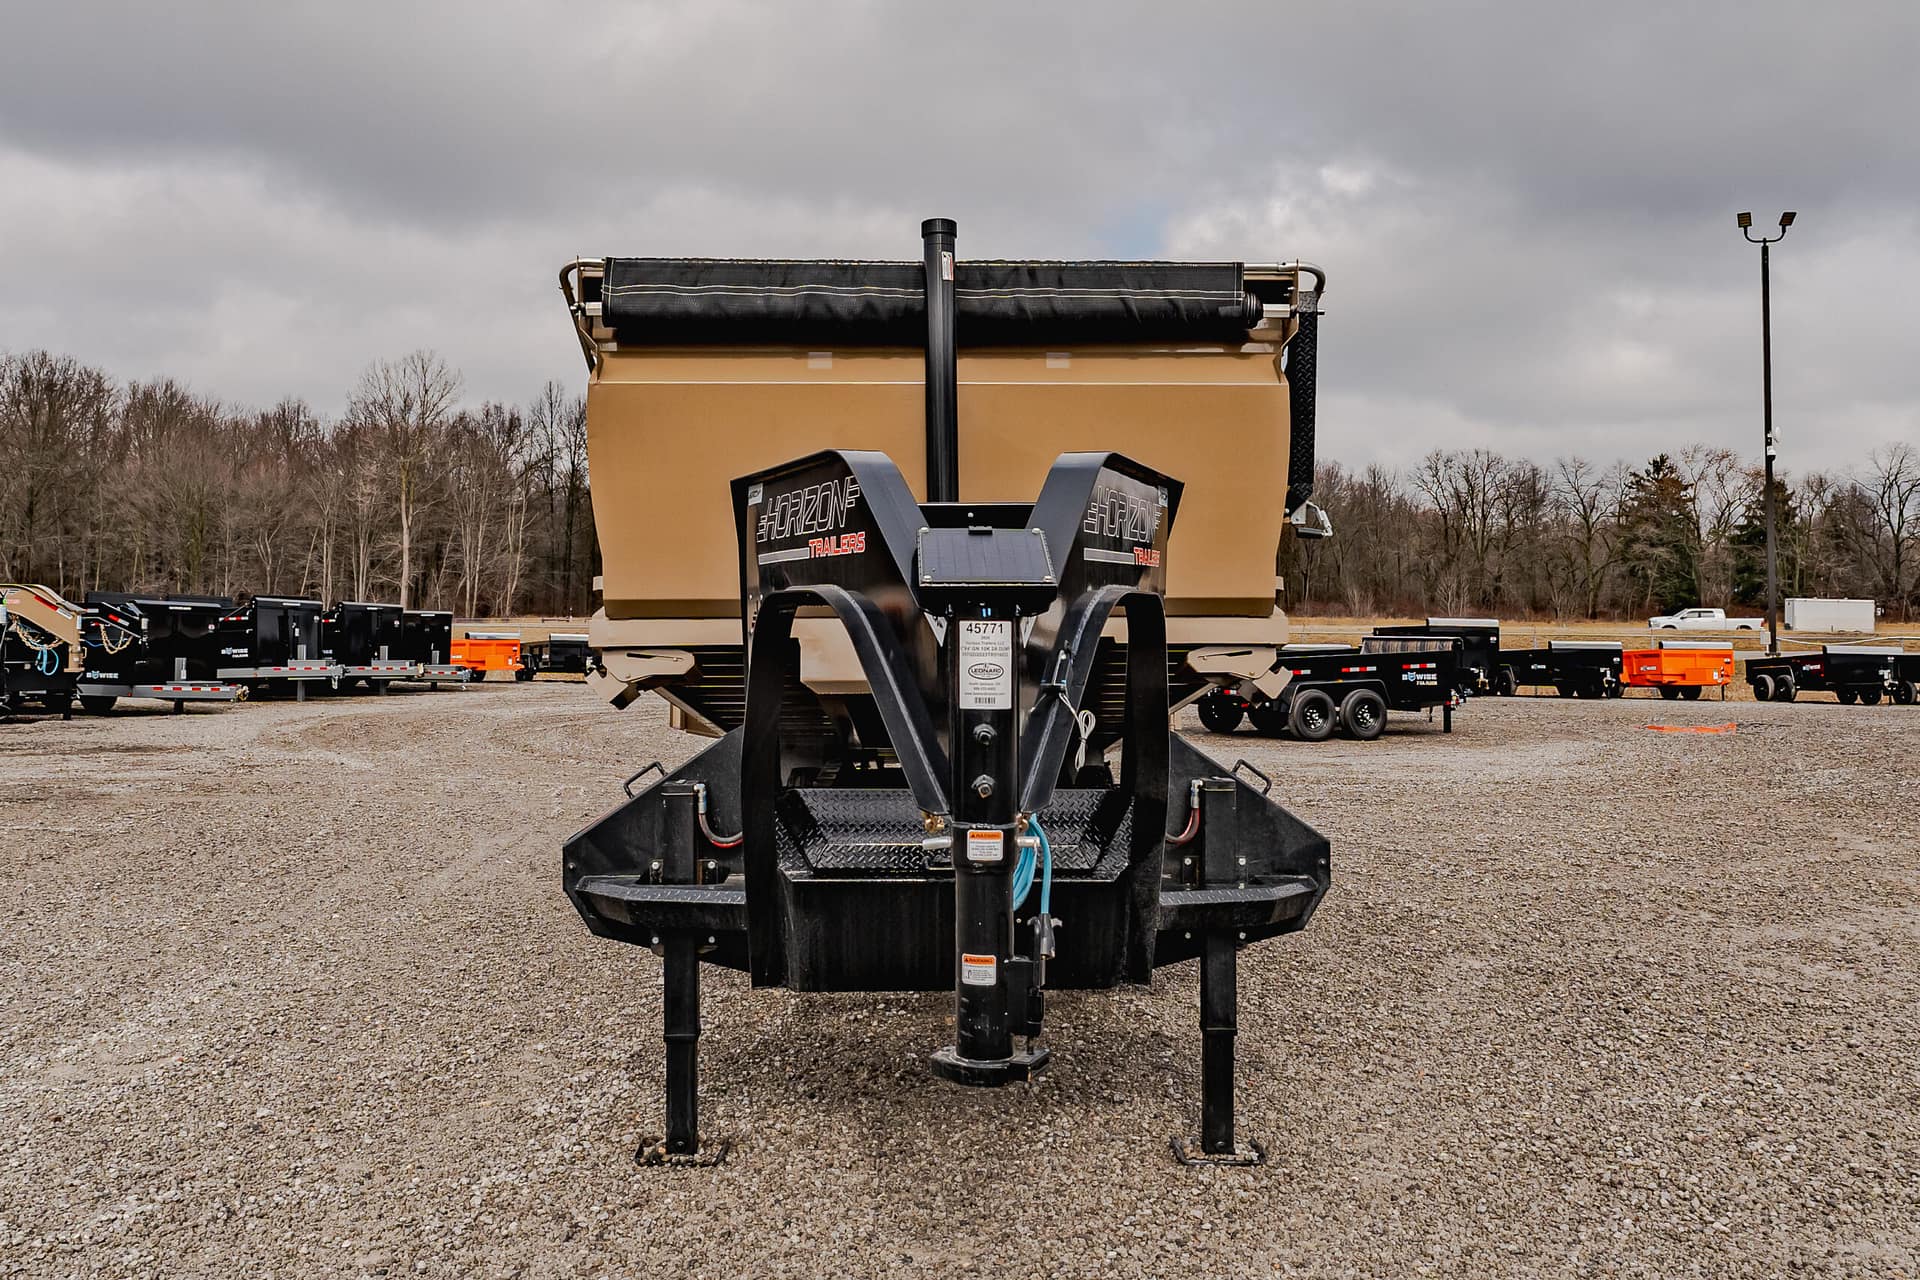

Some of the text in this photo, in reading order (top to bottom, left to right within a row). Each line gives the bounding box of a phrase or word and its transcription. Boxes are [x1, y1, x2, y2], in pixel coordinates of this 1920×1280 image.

[757, 475, 860, 542] HORIZON
[809, 531, 866, 558] TRAILERS
[966, 623, 1003, 634] 45771
